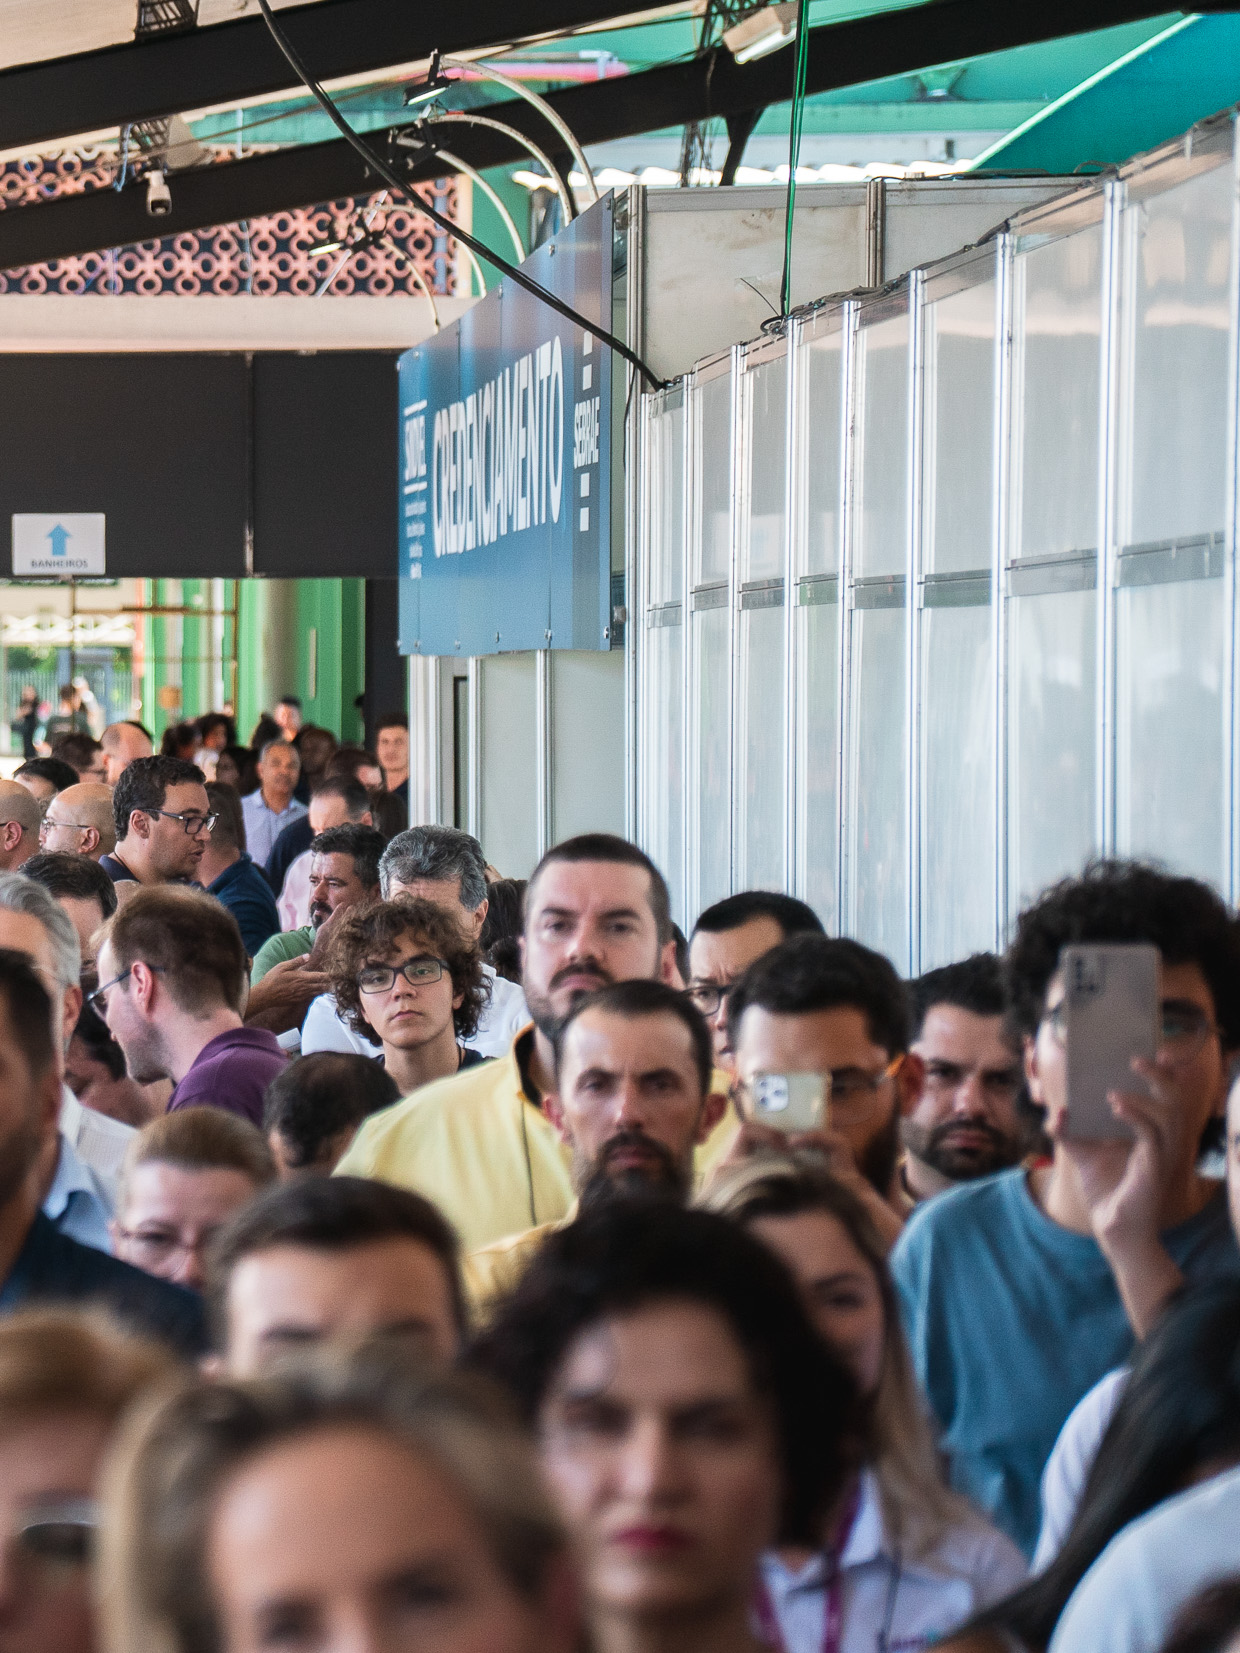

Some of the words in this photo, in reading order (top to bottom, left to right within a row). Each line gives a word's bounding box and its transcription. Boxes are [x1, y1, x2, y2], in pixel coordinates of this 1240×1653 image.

[433, 335, 563, 558] CREDENCIAMENTO
[573, 396, 600, 469] SEBRAE
[31, 560, 88, 568] BANHEIROS
